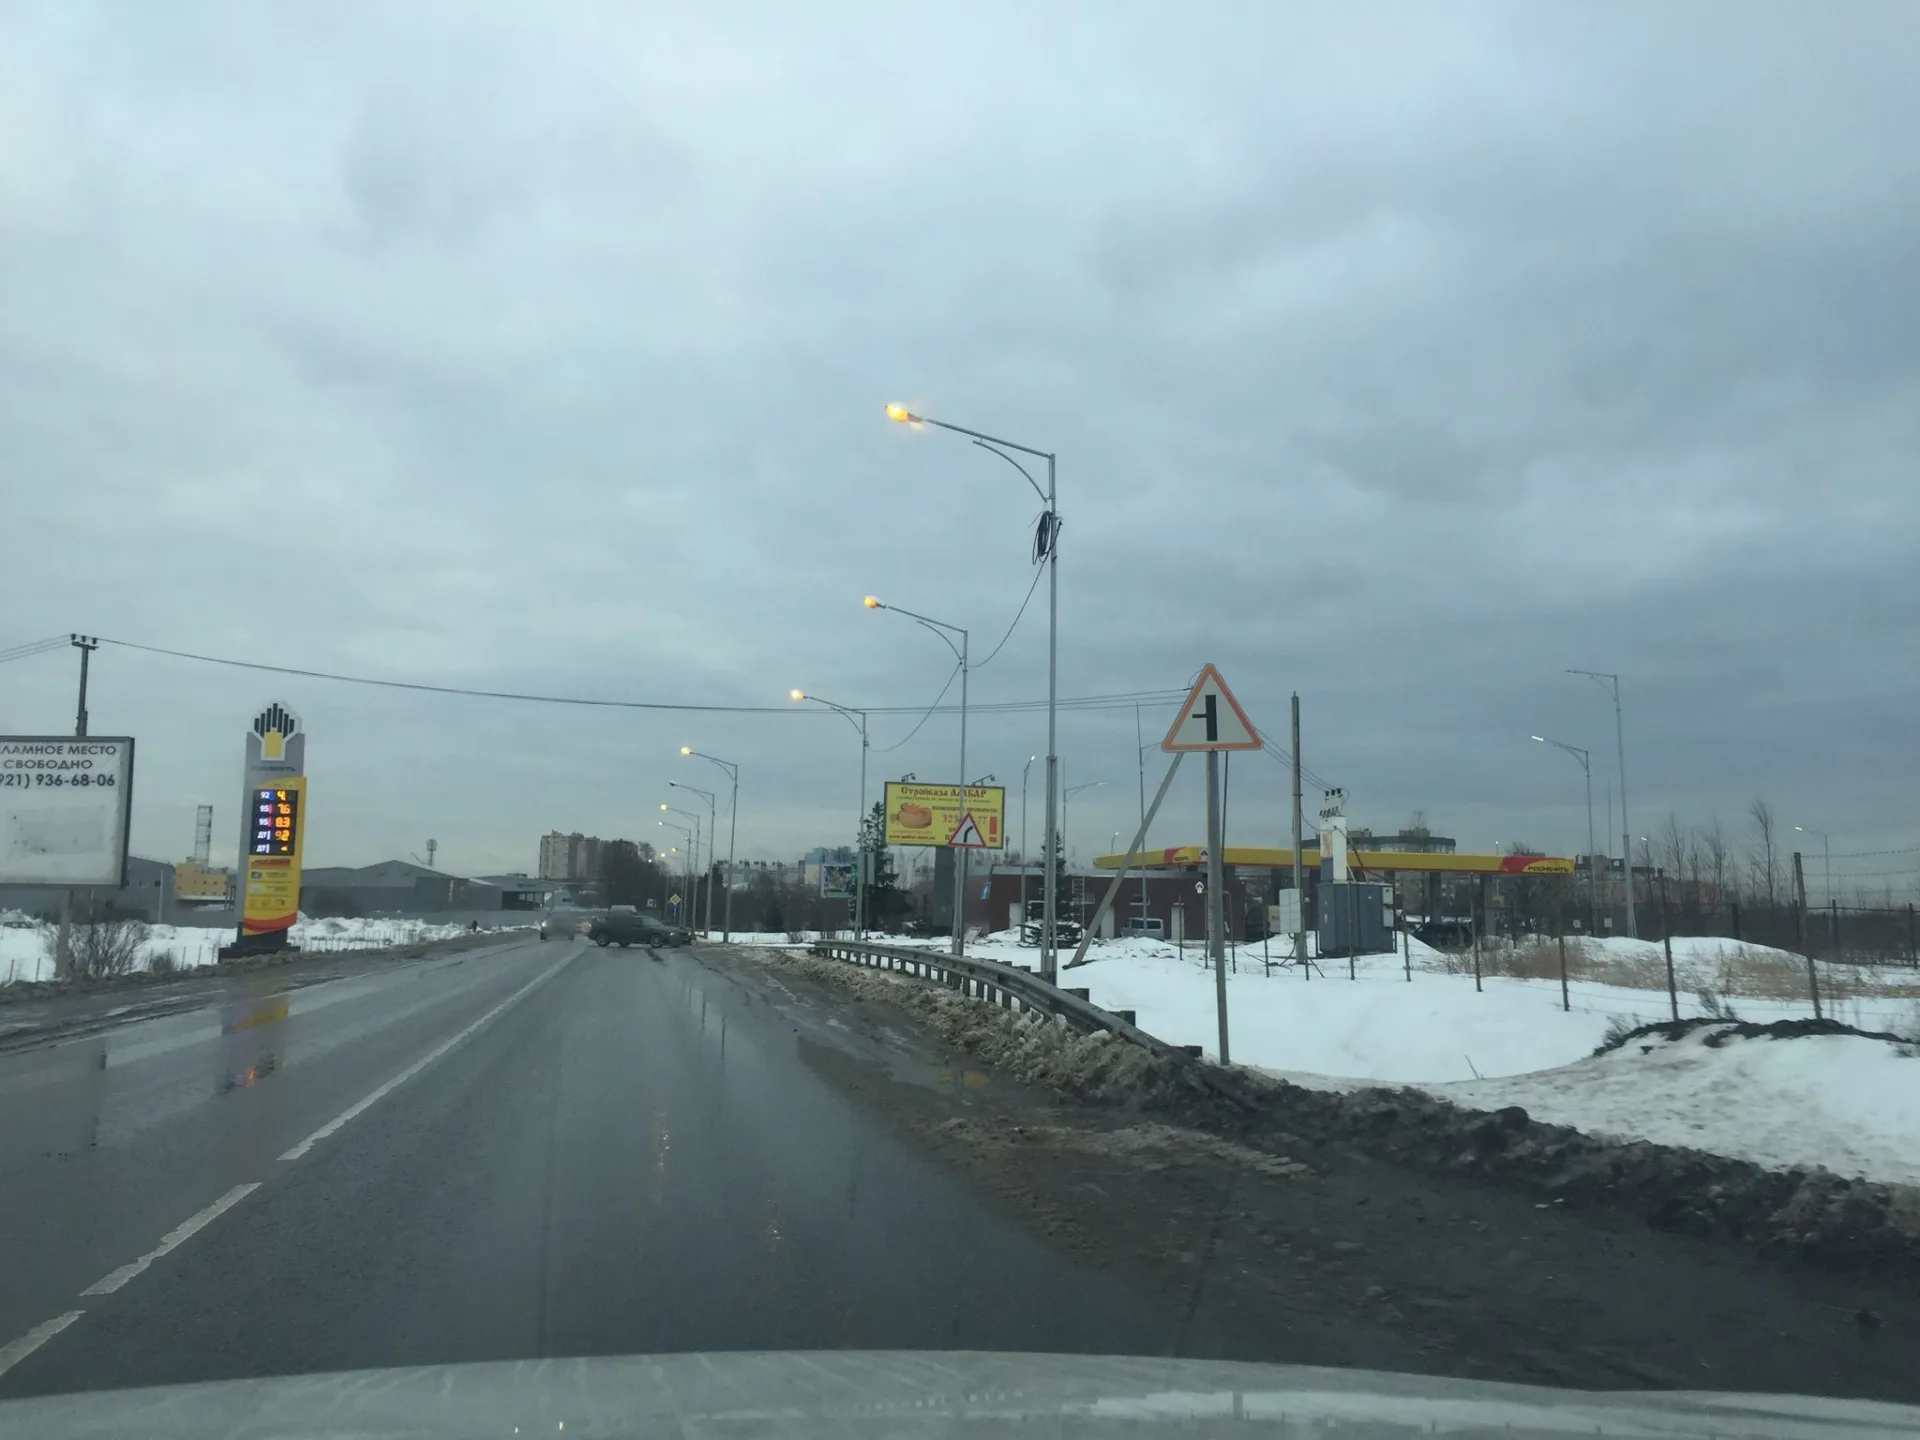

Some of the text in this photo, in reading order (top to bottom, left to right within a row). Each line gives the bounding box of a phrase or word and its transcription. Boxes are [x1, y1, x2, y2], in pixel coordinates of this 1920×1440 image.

[68, 745, 117, 755] МЕСТО
[3, 759, 93, 770] СВОБОДНО
[36, 774, 115, 786] 936-68-06
